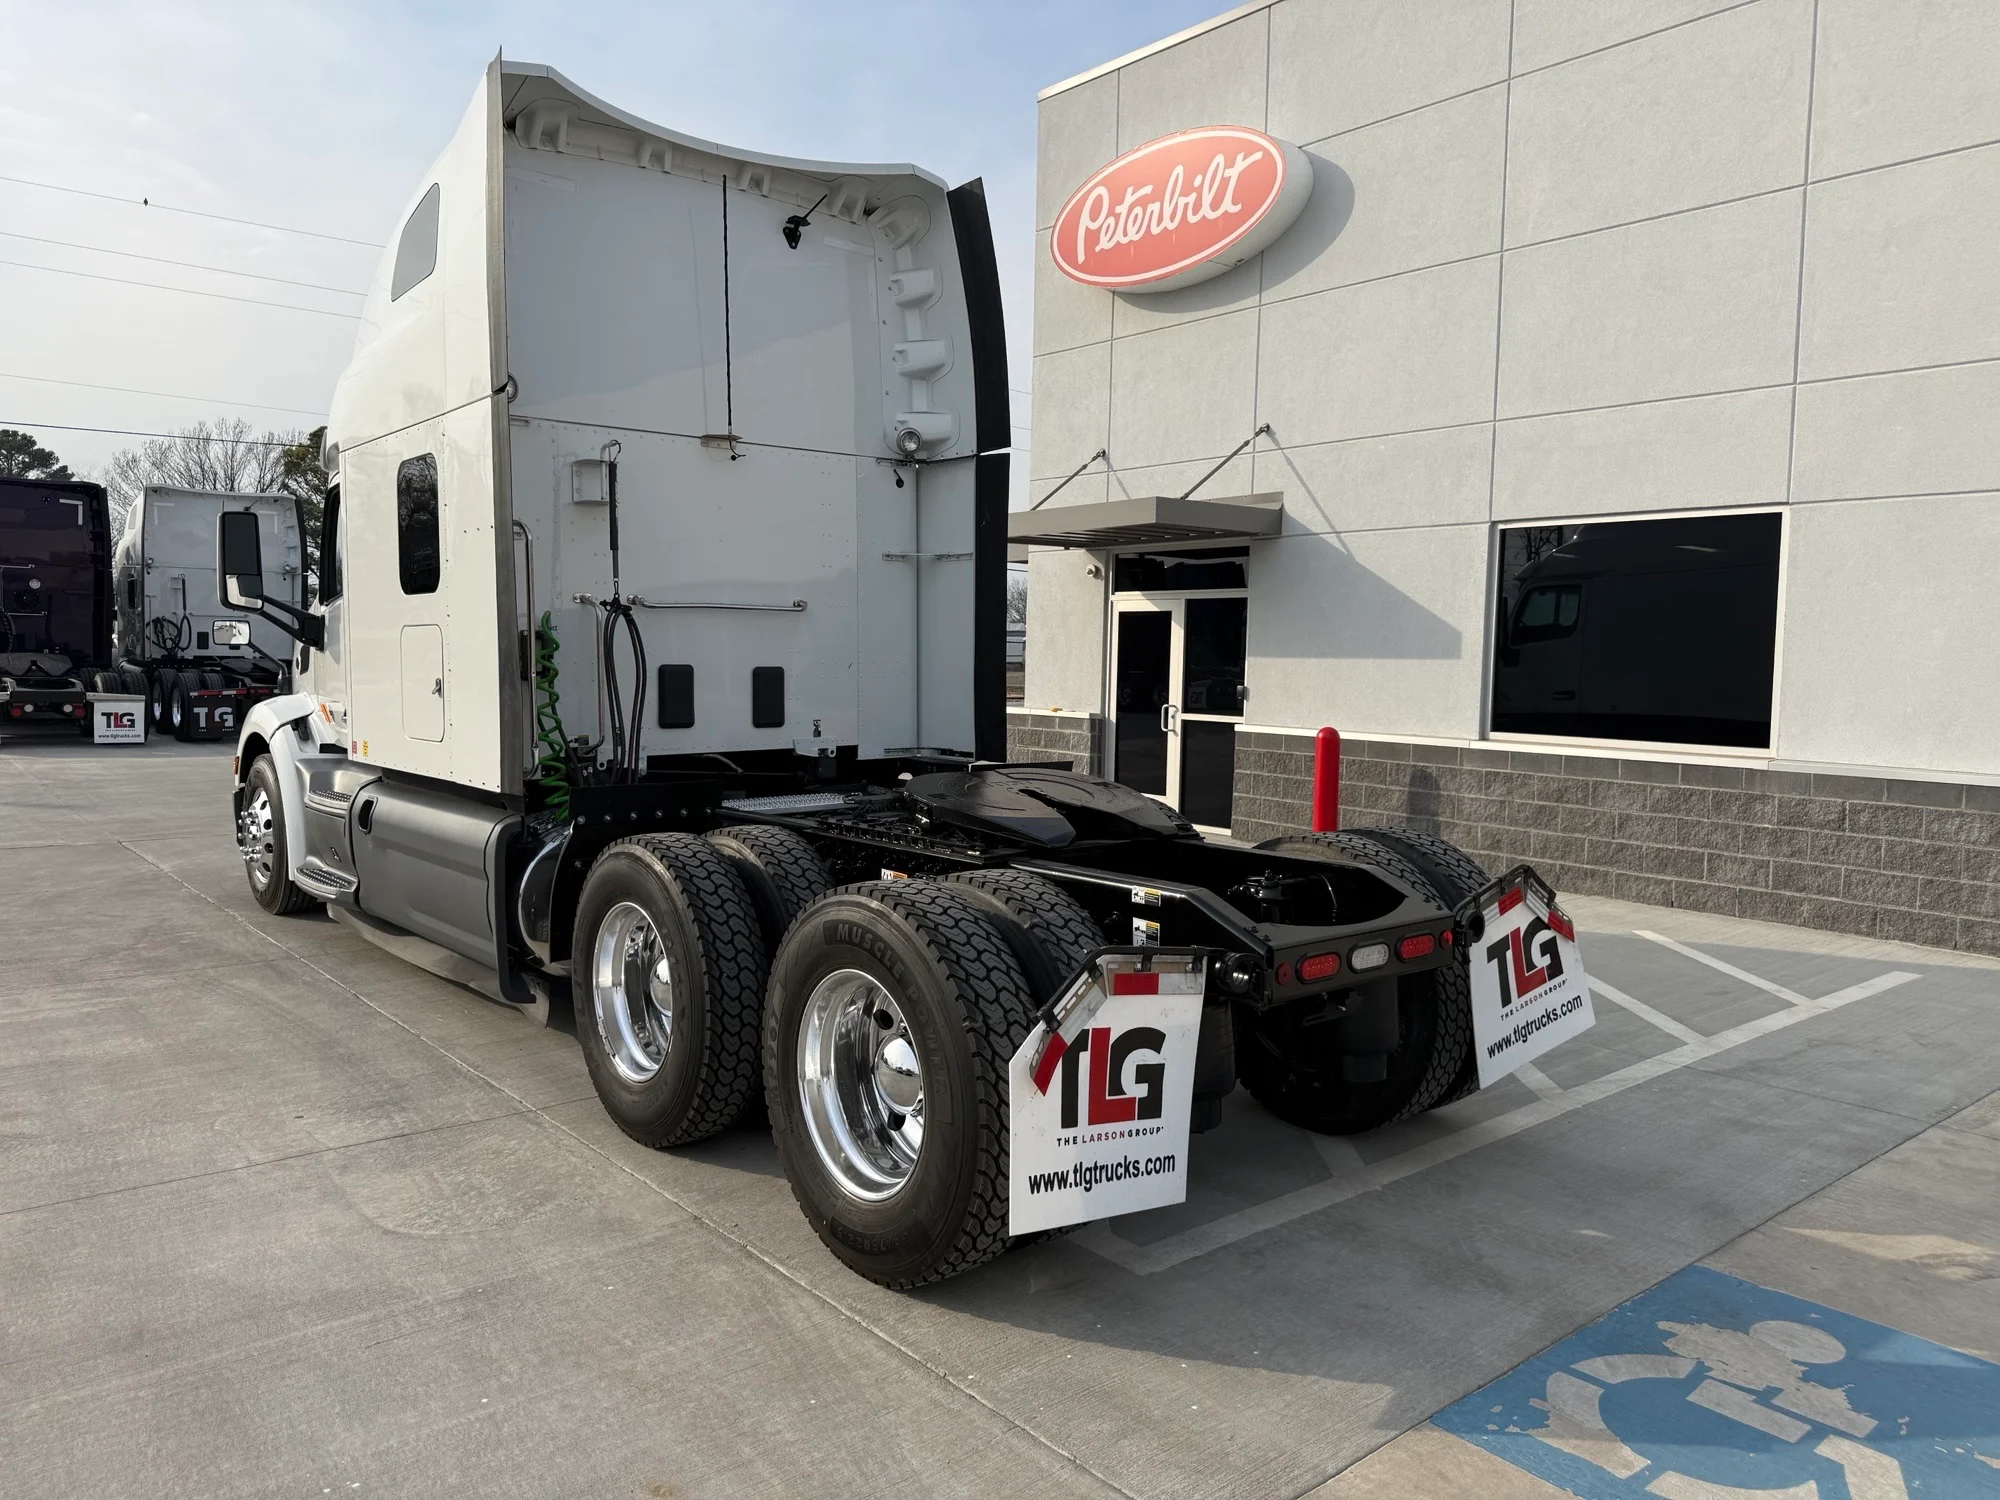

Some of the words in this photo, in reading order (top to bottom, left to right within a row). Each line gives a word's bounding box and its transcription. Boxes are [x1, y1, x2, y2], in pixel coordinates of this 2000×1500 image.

[1077, 150, 1263, 265] Peterbilt
[101, 712, 136, 728] TLG
[1486, 915, 1564, 1009] TLG
[836, 922, 905, 980] MUSCLE
[905, 983, 948, 1096] POWER
[1486, 994, 1583, 1059] www.tlgtrucks.com
[1501, 1009, 1514, 1021] THE
[1515, 993, 1544, 1012] LARSON
[1544, 978, 1568, 996] GROUP
[1060, 1026, 1167, 1129] TLG
[1057, 1137, 1079, 1147] THE
[1081, 1130, 1126, 1144] LARSON
[1127, 1127, 1164, 1138] GROUP
[1028, 1153, 1176, 1194] www.tlgtrucks.com
